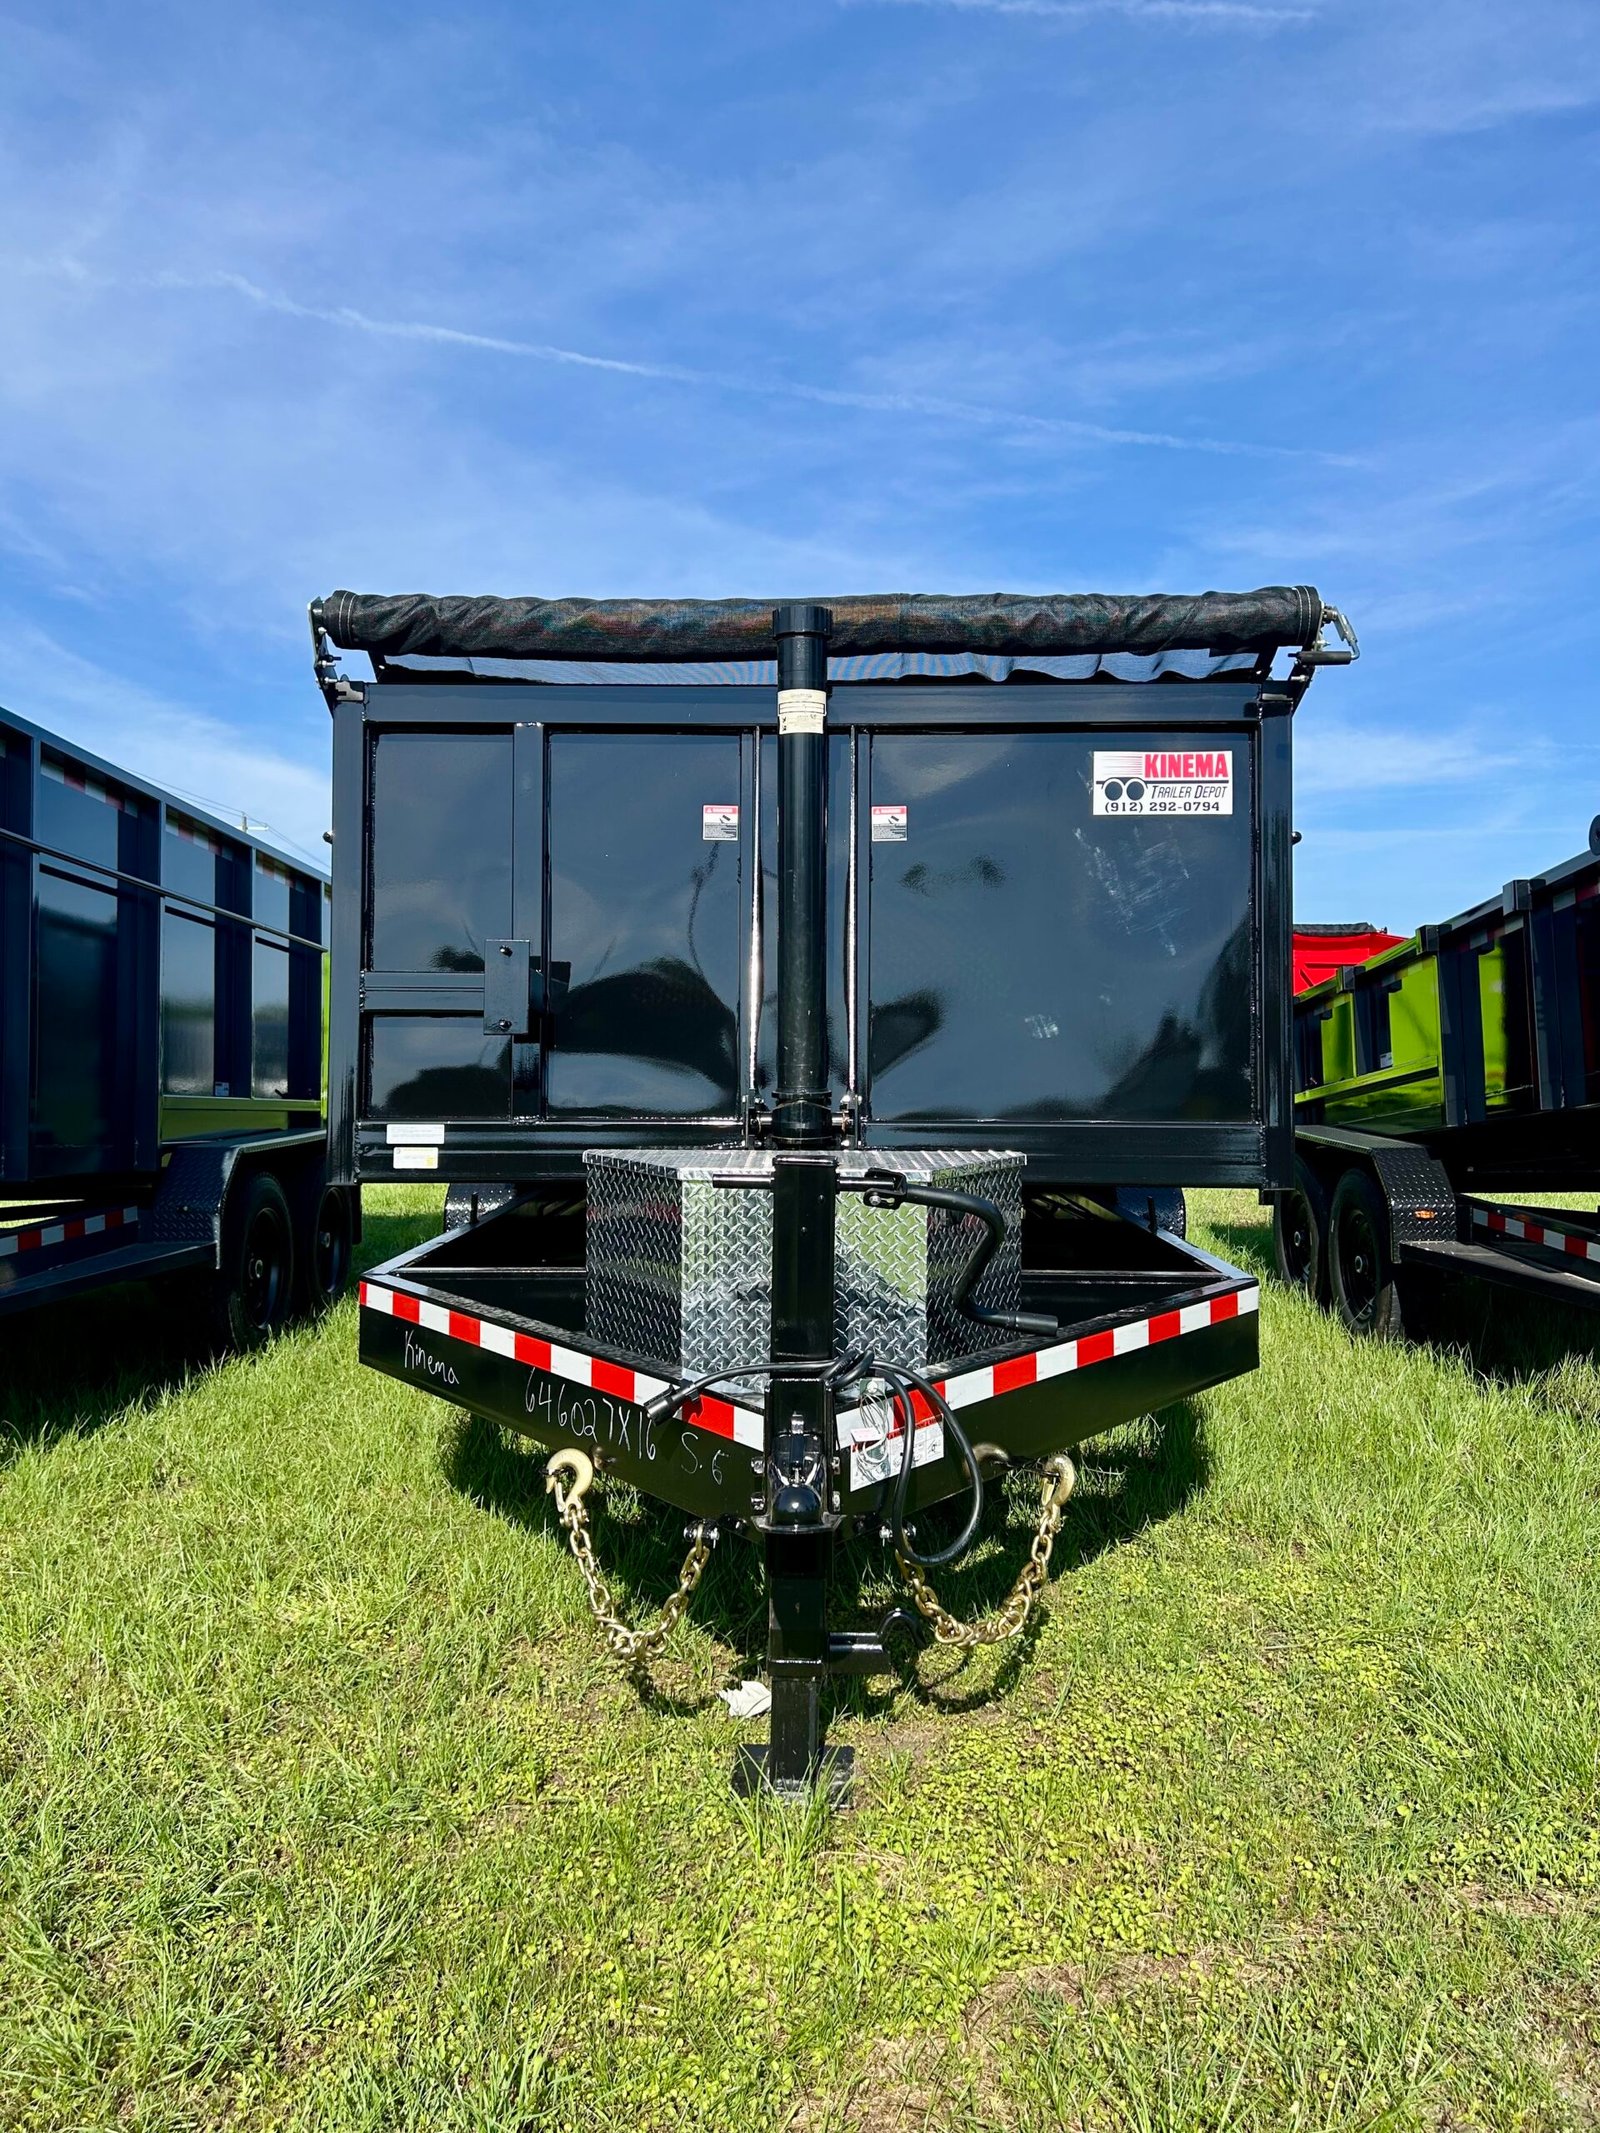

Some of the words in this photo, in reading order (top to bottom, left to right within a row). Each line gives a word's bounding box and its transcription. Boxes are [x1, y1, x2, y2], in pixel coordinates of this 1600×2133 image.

[1144, 753, 1229, 778] KINEMA
[1151, 785, 1192, 799] TRAILER
[1194, 784, 1228, 799] DEPOT
[1104, 801, 1144, 813] (912)
[1149, 801, 1220, 812] 292-0794
[404, 1329, 460, 1385] Kinema
